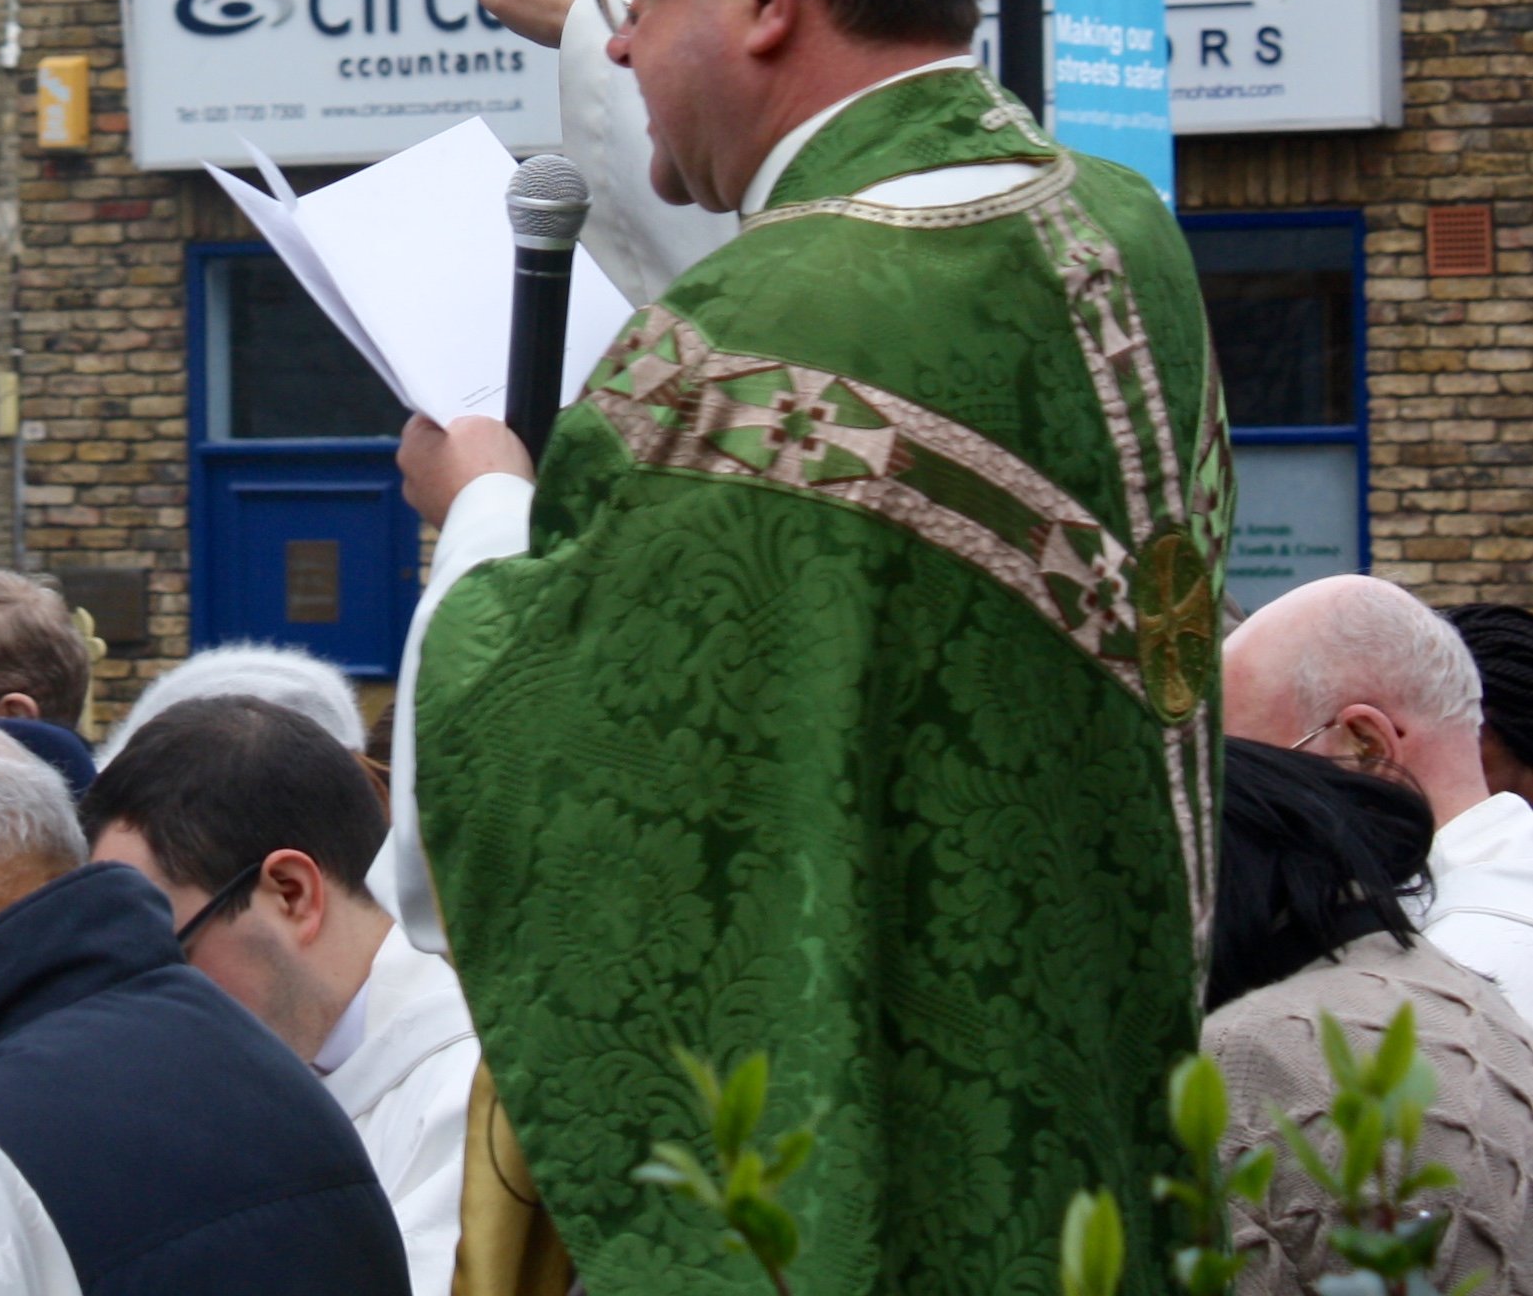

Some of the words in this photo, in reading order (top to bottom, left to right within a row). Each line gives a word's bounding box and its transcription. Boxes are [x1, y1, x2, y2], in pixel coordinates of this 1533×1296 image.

[1055, 13, 1123, 56] Making
[1126, 27, 1155, 51] our
[339, 49, 525, 78] ccountants
[1055, 57, 1120, 87] streets
[1123, 60, 1166, 90] safer
